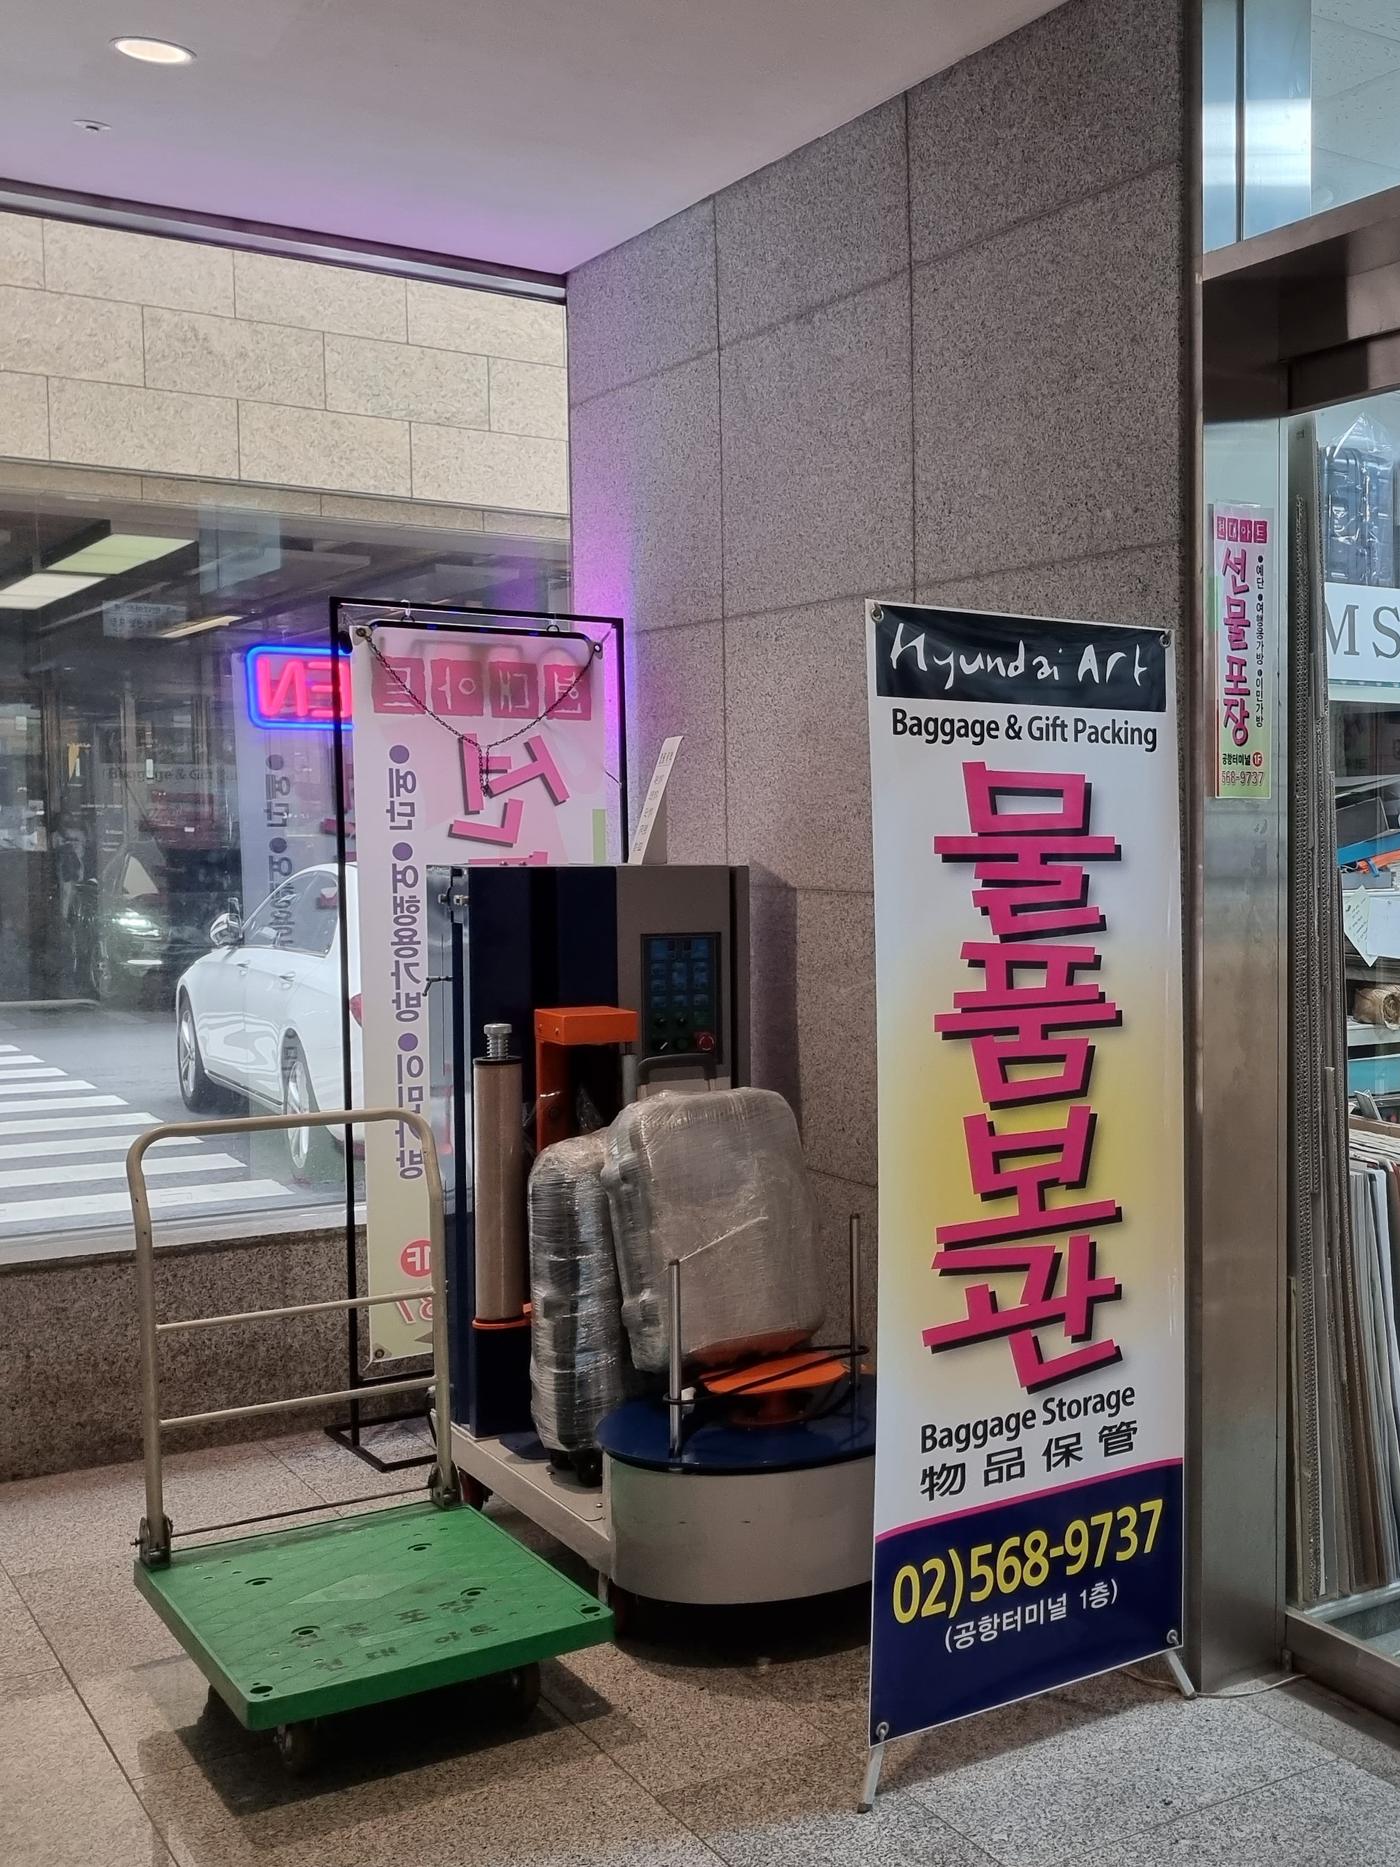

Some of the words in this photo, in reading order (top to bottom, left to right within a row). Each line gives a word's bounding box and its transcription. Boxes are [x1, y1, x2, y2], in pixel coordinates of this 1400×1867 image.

[889, 622, 1062, 690] Hyundai
[1077, 643, 1148, 687] Art
[1222, 547, 1251, 747] 선물포장
[891, 707, 1000, 746] Baggage
[1004, 714, 1023, 741] &
[1027, 714, 1068, 743] Gift
[1073, 718, 1158, 753] Packing
[1221, 770, 1264, 787] 568-9737
[920, 1408, 1037, 1455] Baggage
[1041, 1385, 1137, 1427] Storage
[919, 1420, 1139, 1502] 物品保管
[892, 1498, 1164, 1625] 02)568-9737
[944, 1593, 1069, 1653] (공항터미널
[1079, 1578, 1119, 1611] 1층)
